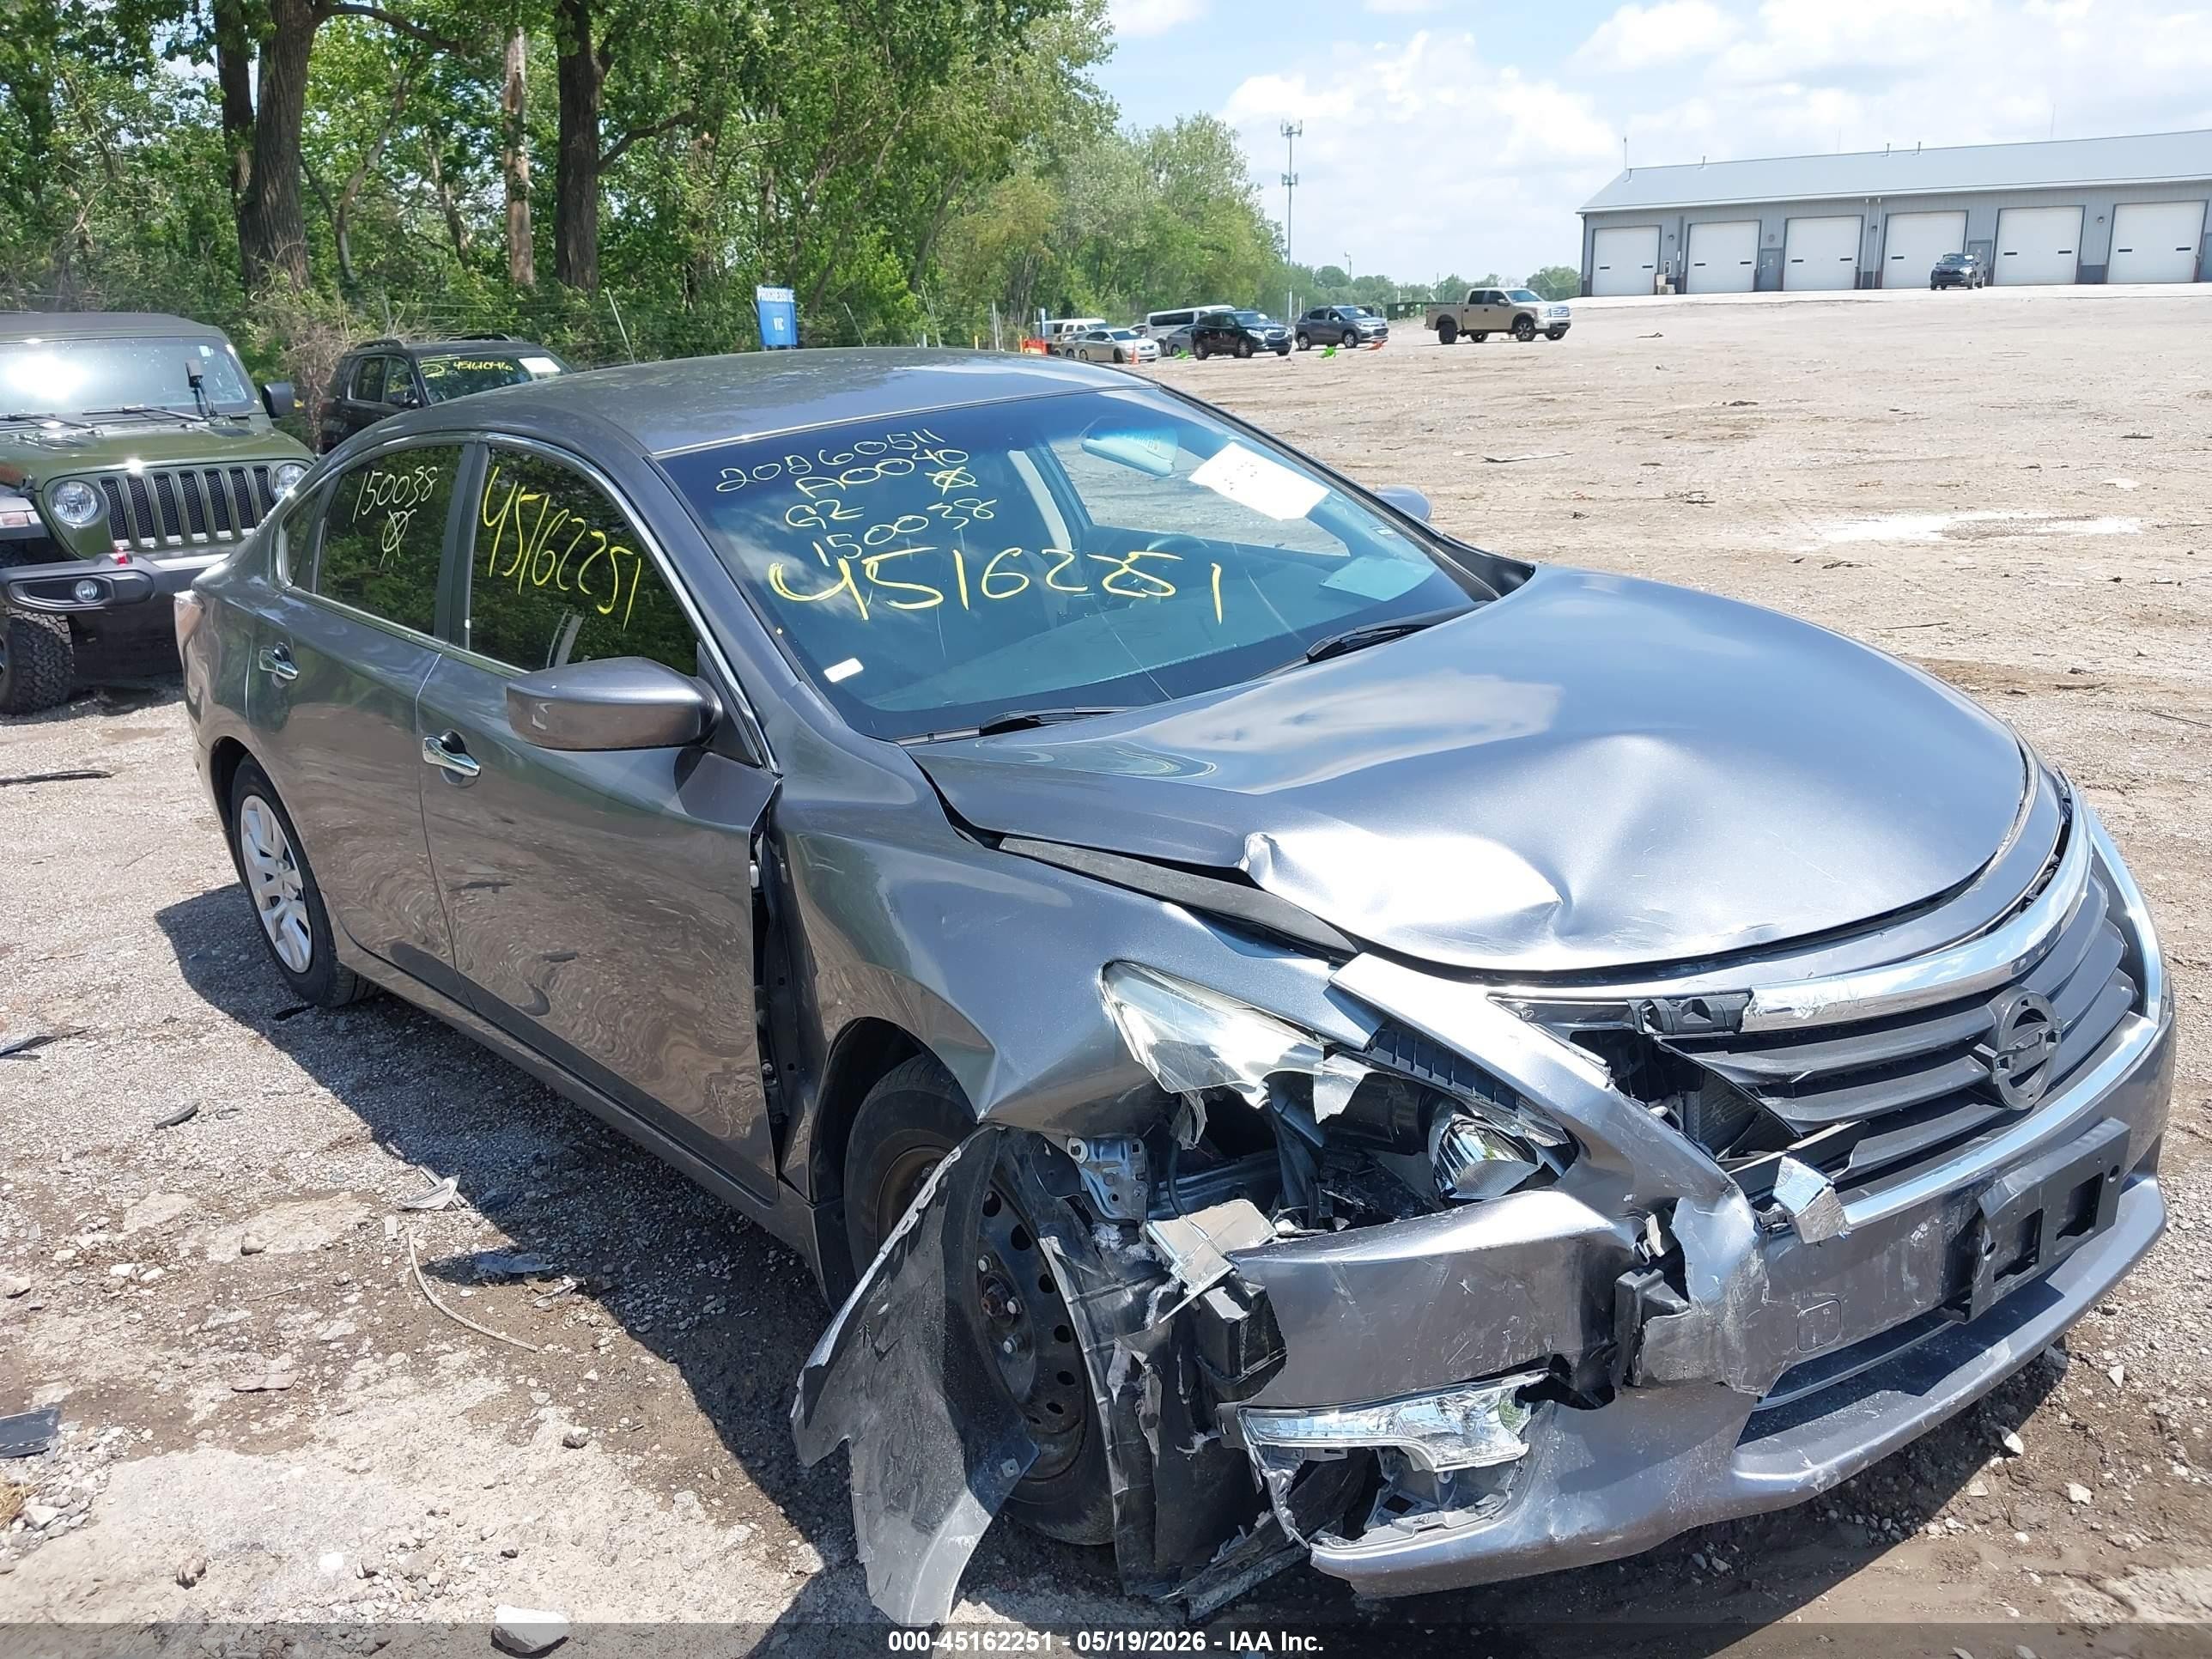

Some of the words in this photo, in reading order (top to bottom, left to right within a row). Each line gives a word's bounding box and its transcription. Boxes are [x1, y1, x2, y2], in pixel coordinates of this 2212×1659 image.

[352, 465, 439, 524] 150038
[715, 428, 946, 492] 20260511
[482, 465, 642, 633] 45162251
[811, 497, 999, 567] 150038
[768, 546, 1224, 624] 45162251
